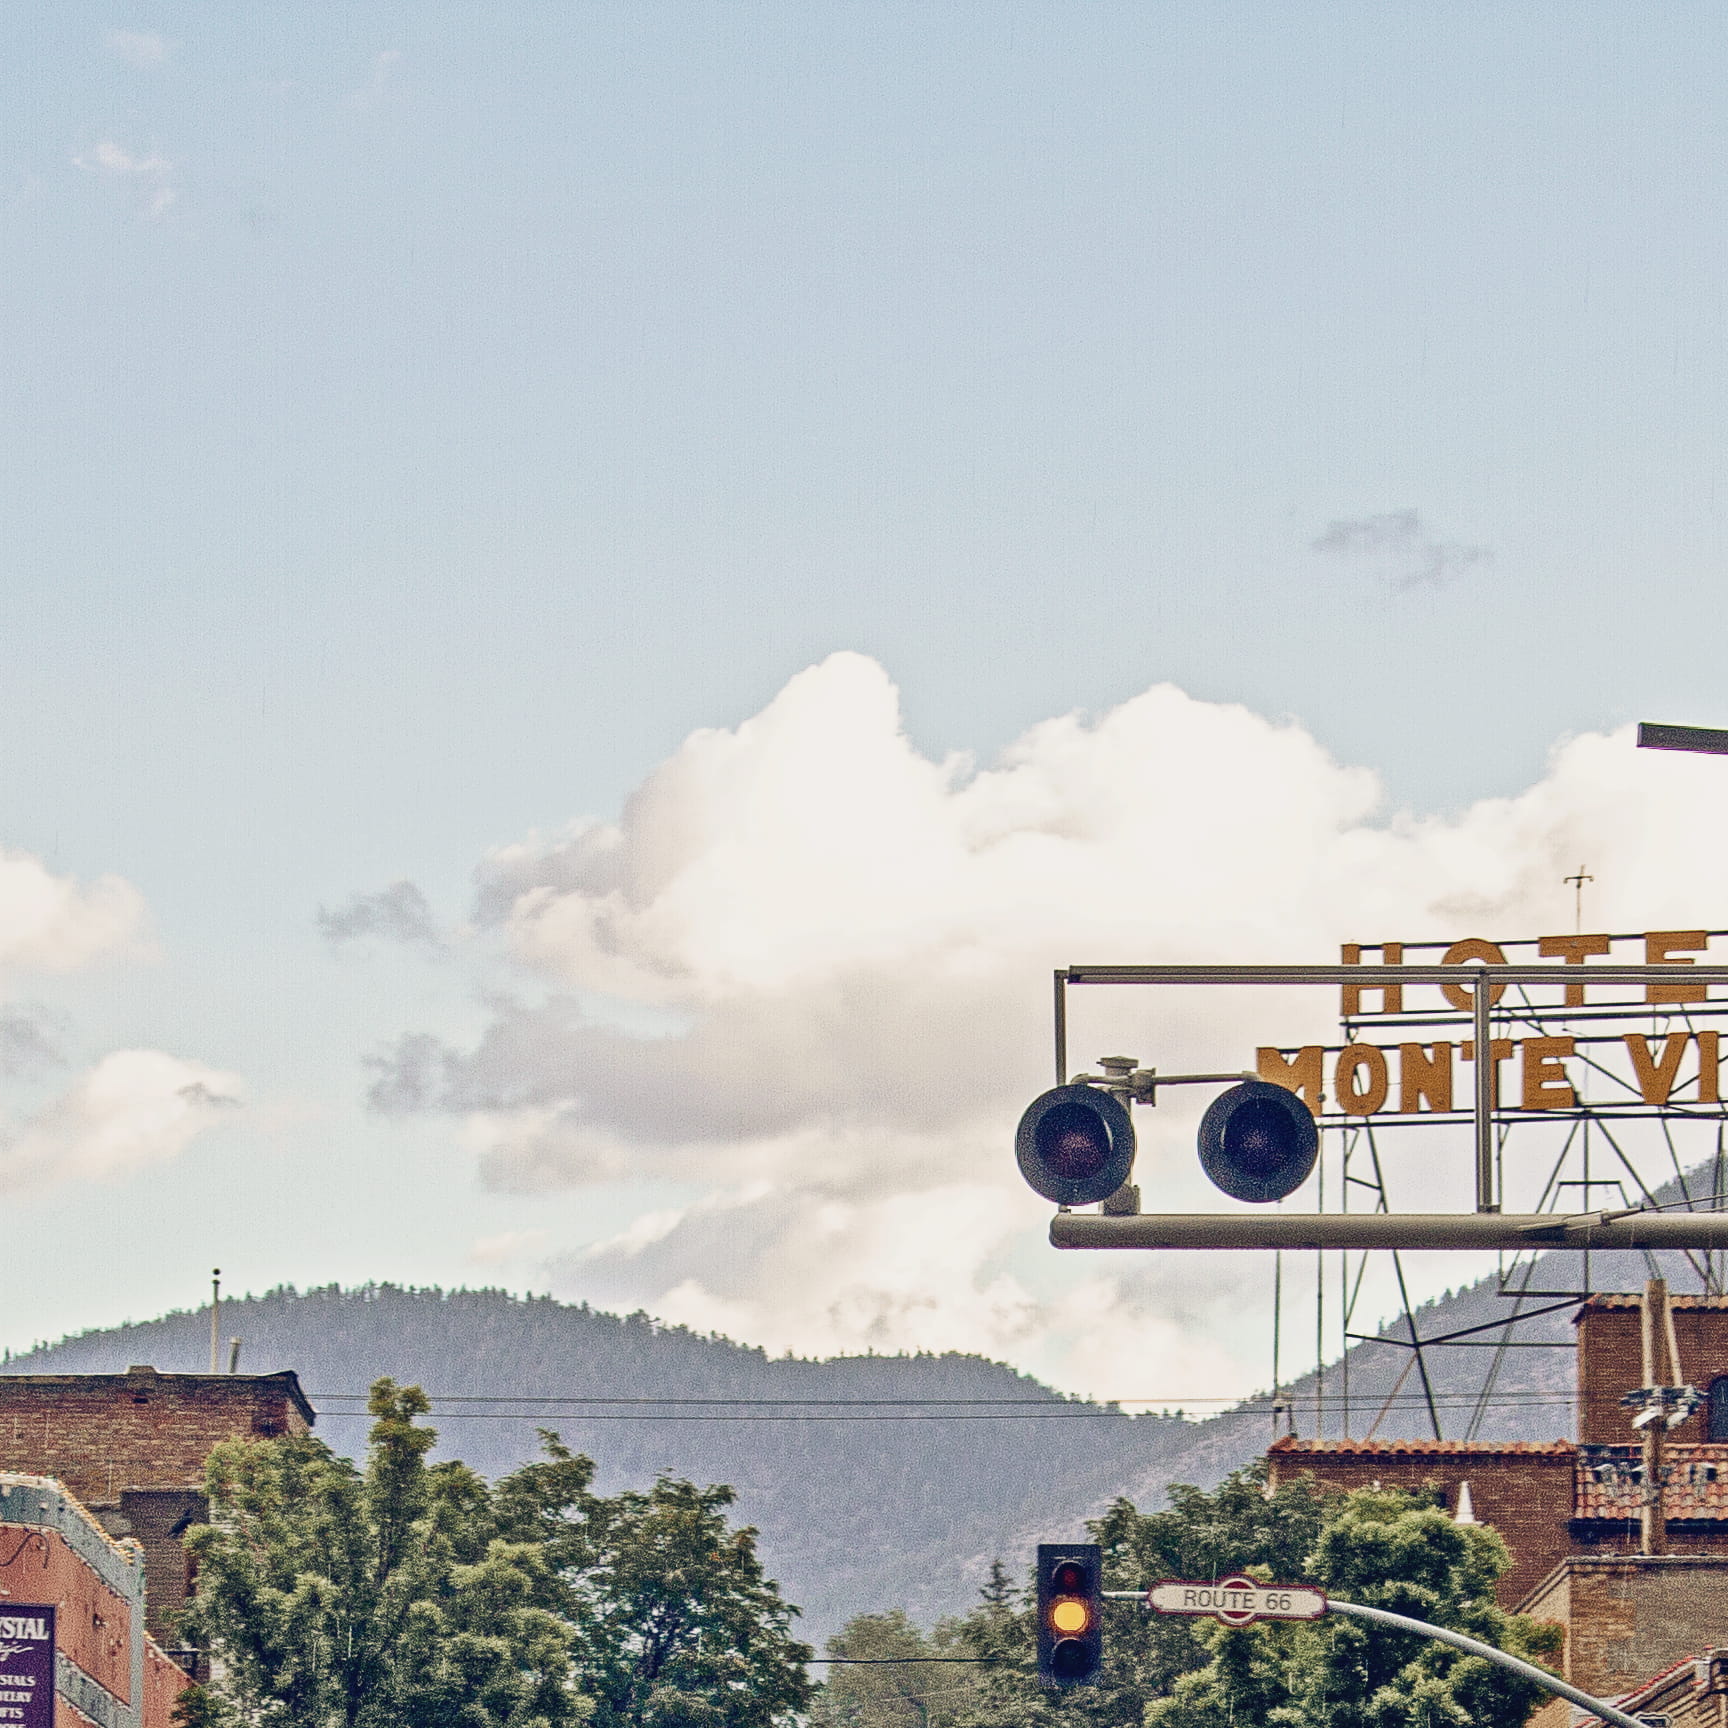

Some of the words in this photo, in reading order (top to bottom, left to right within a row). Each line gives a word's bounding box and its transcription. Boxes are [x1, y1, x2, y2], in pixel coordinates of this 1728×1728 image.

[1256, 1036, 1576, 1117] MONTE
[1183, 1590, 1255, 1609] ROUTE
[1266, 1593, 1292, 1610] 66
